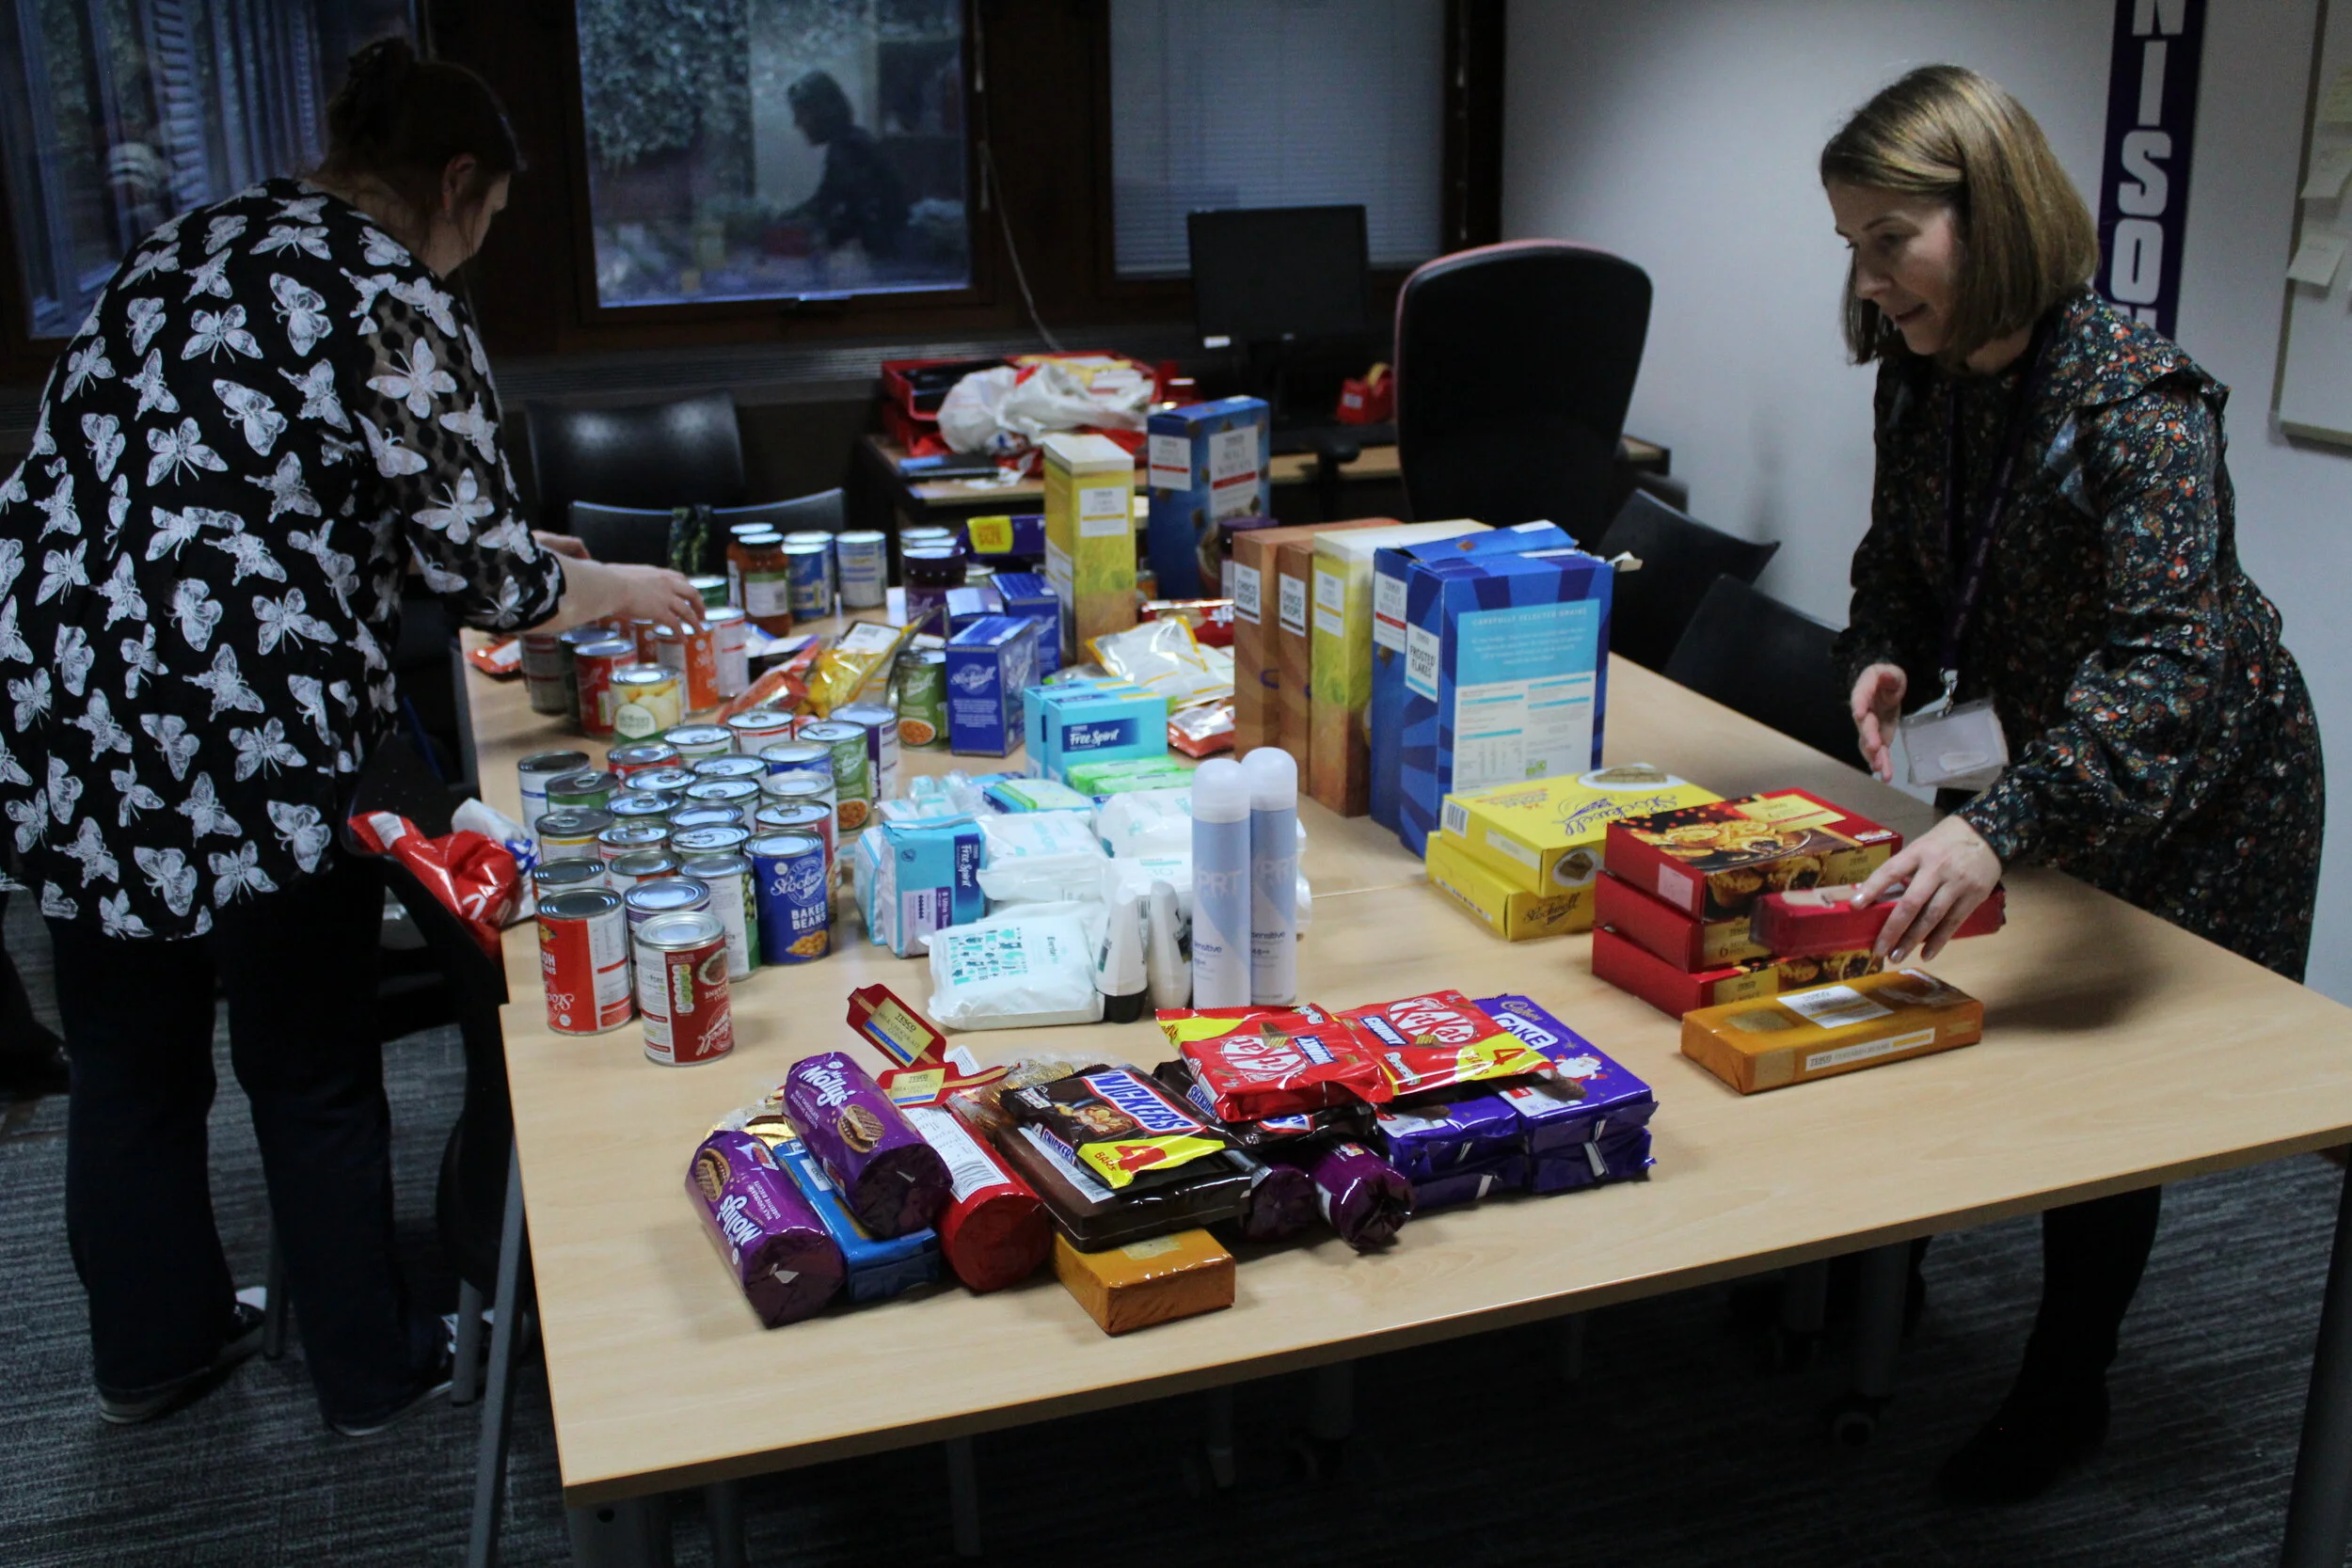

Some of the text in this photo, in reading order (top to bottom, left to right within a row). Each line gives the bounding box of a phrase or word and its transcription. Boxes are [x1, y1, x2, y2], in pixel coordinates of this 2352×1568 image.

[2110, 0, 2185, 331] ISO
[1070, 732, 1091, 746] Free
[1091, 727, 1120, 747] Spirit
[958, 844, 974, 888] Free Spirit
[791, 901, 826, 920] BAKED
[792, 911, 827, 930] BEANS
[894, 1011, 917, 1033] TESCO
[1391, 1001, 1475, 1044] KitKat
[1494, 1017, 1548, 1049] CAKE
[1492, 1047, 1526, 1067] 4
[798, 1065, 857, 1107] Molly's
[1042, 1129, 1076, 1164] SNICKERS
[1094, 1151, 1117, 1172] BARS
[716, 1194, 763, 1247] Molly's
